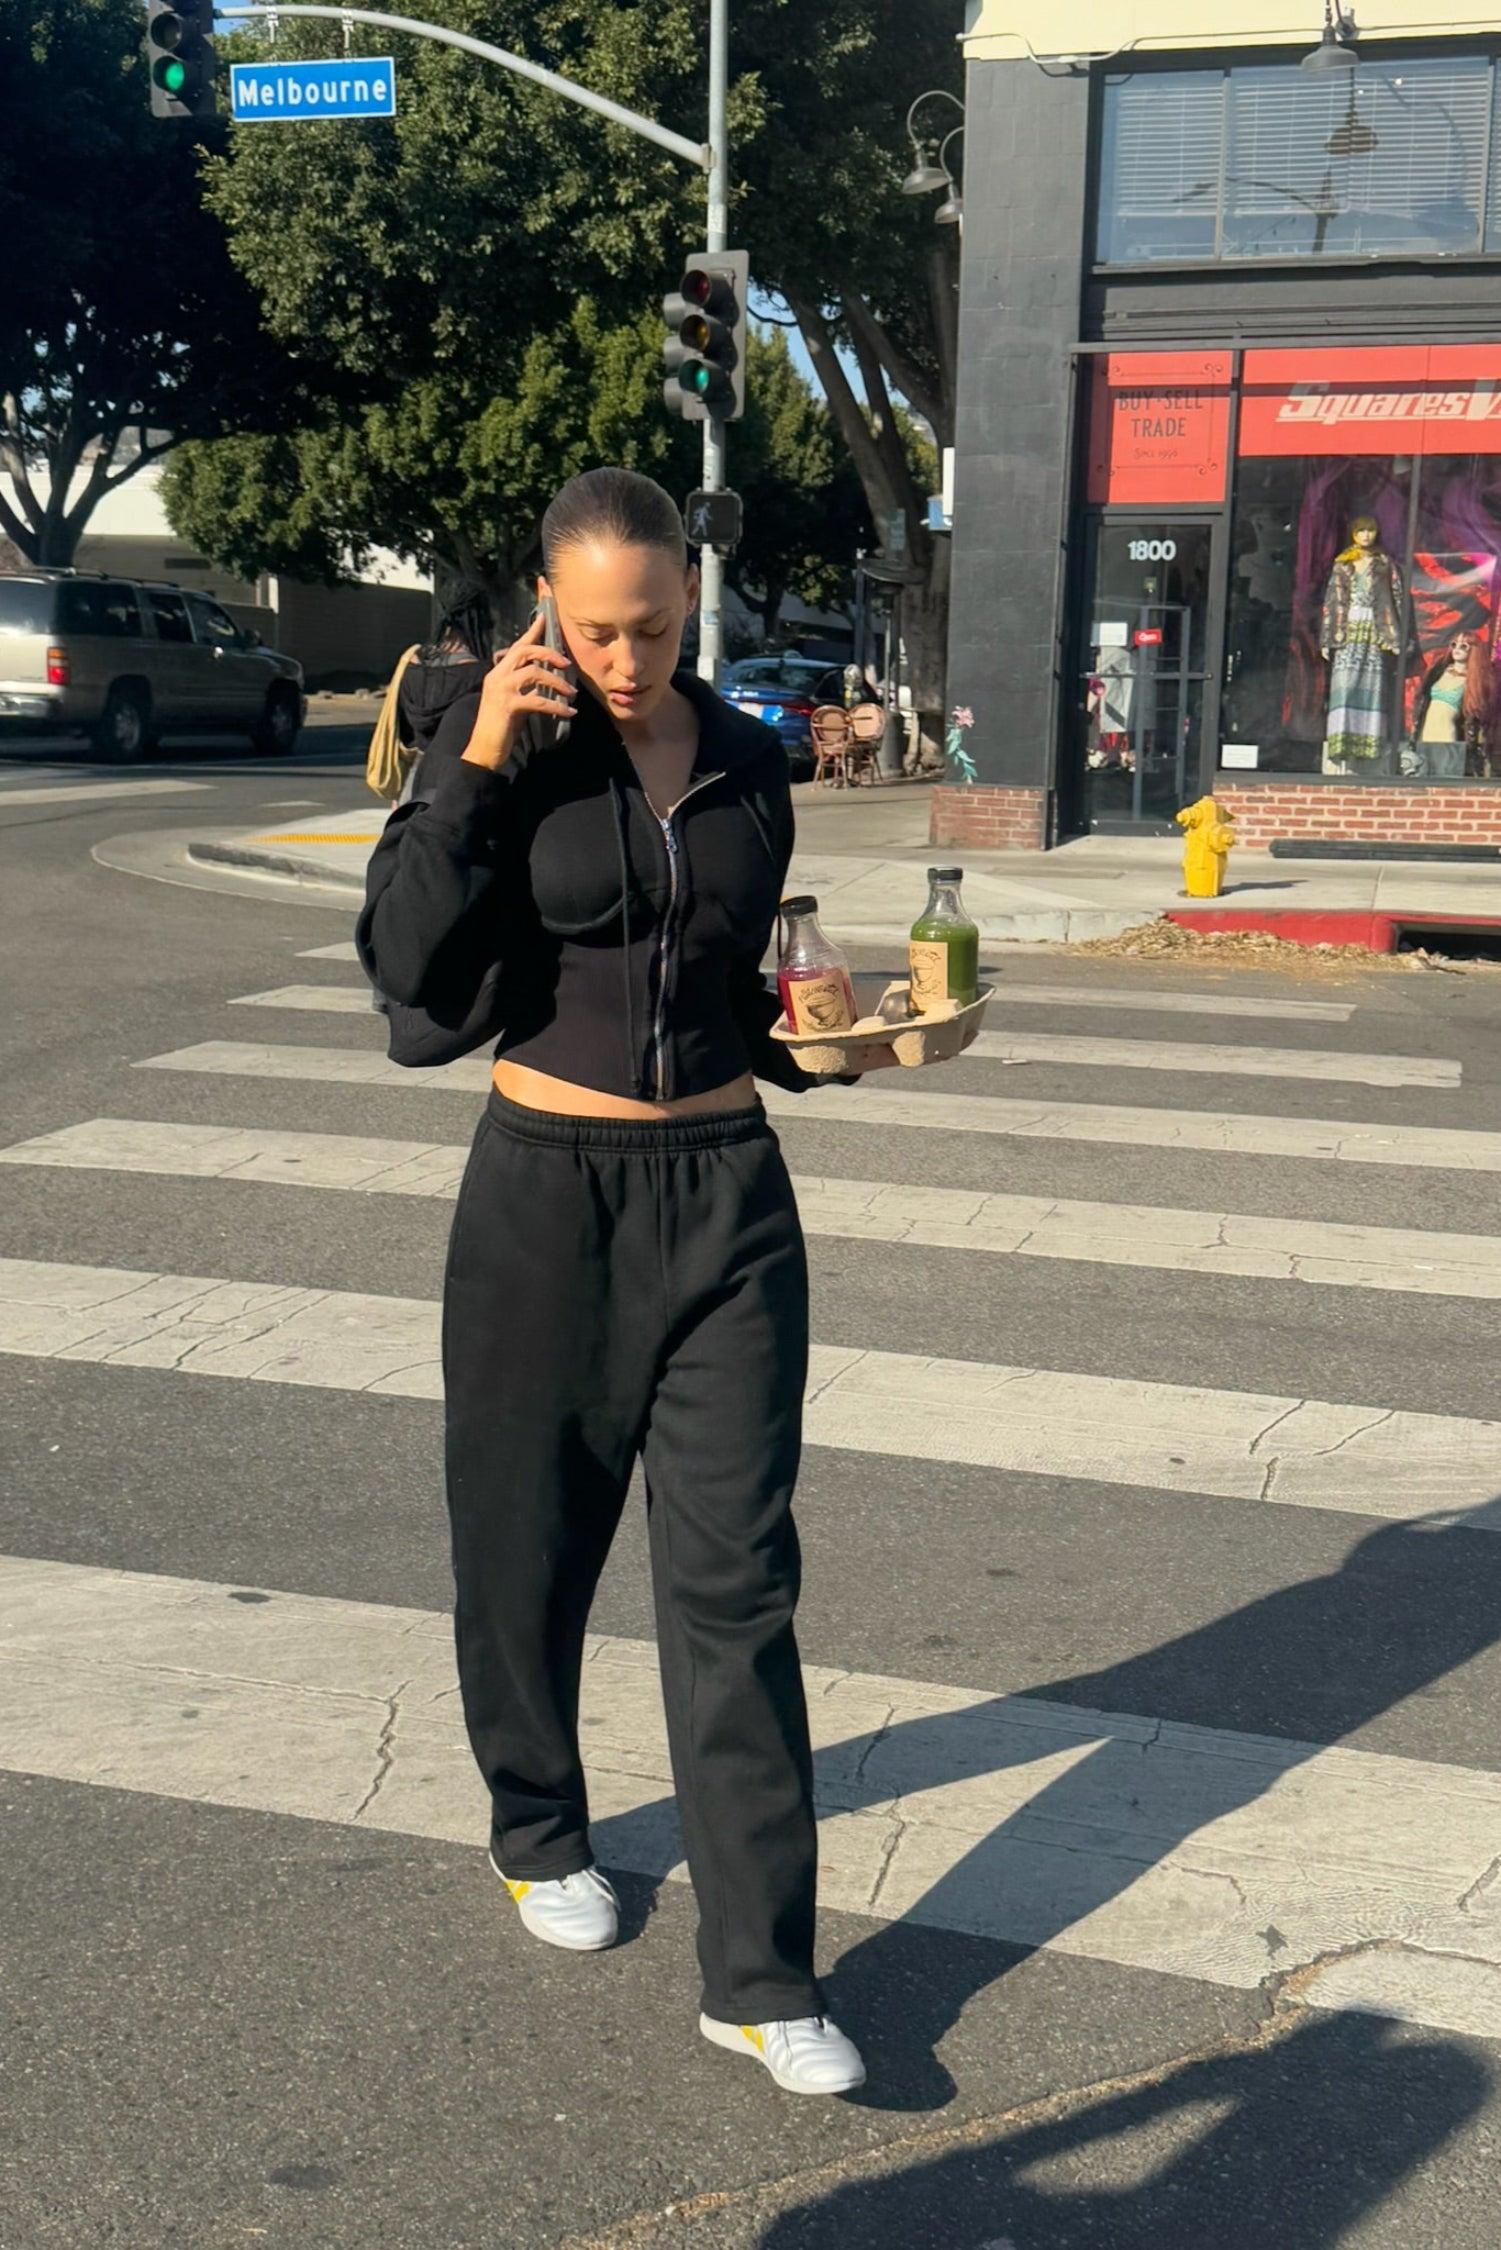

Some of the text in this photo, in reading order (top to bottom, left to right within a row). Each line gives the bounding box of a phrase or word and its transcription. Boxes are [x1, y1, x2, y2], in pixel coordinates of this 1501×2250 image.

[238, 77, 387, 107] Melbourne
[1131, 417, 1187, 438] TRADE
[1128, 539, 1176, 561] 1800
